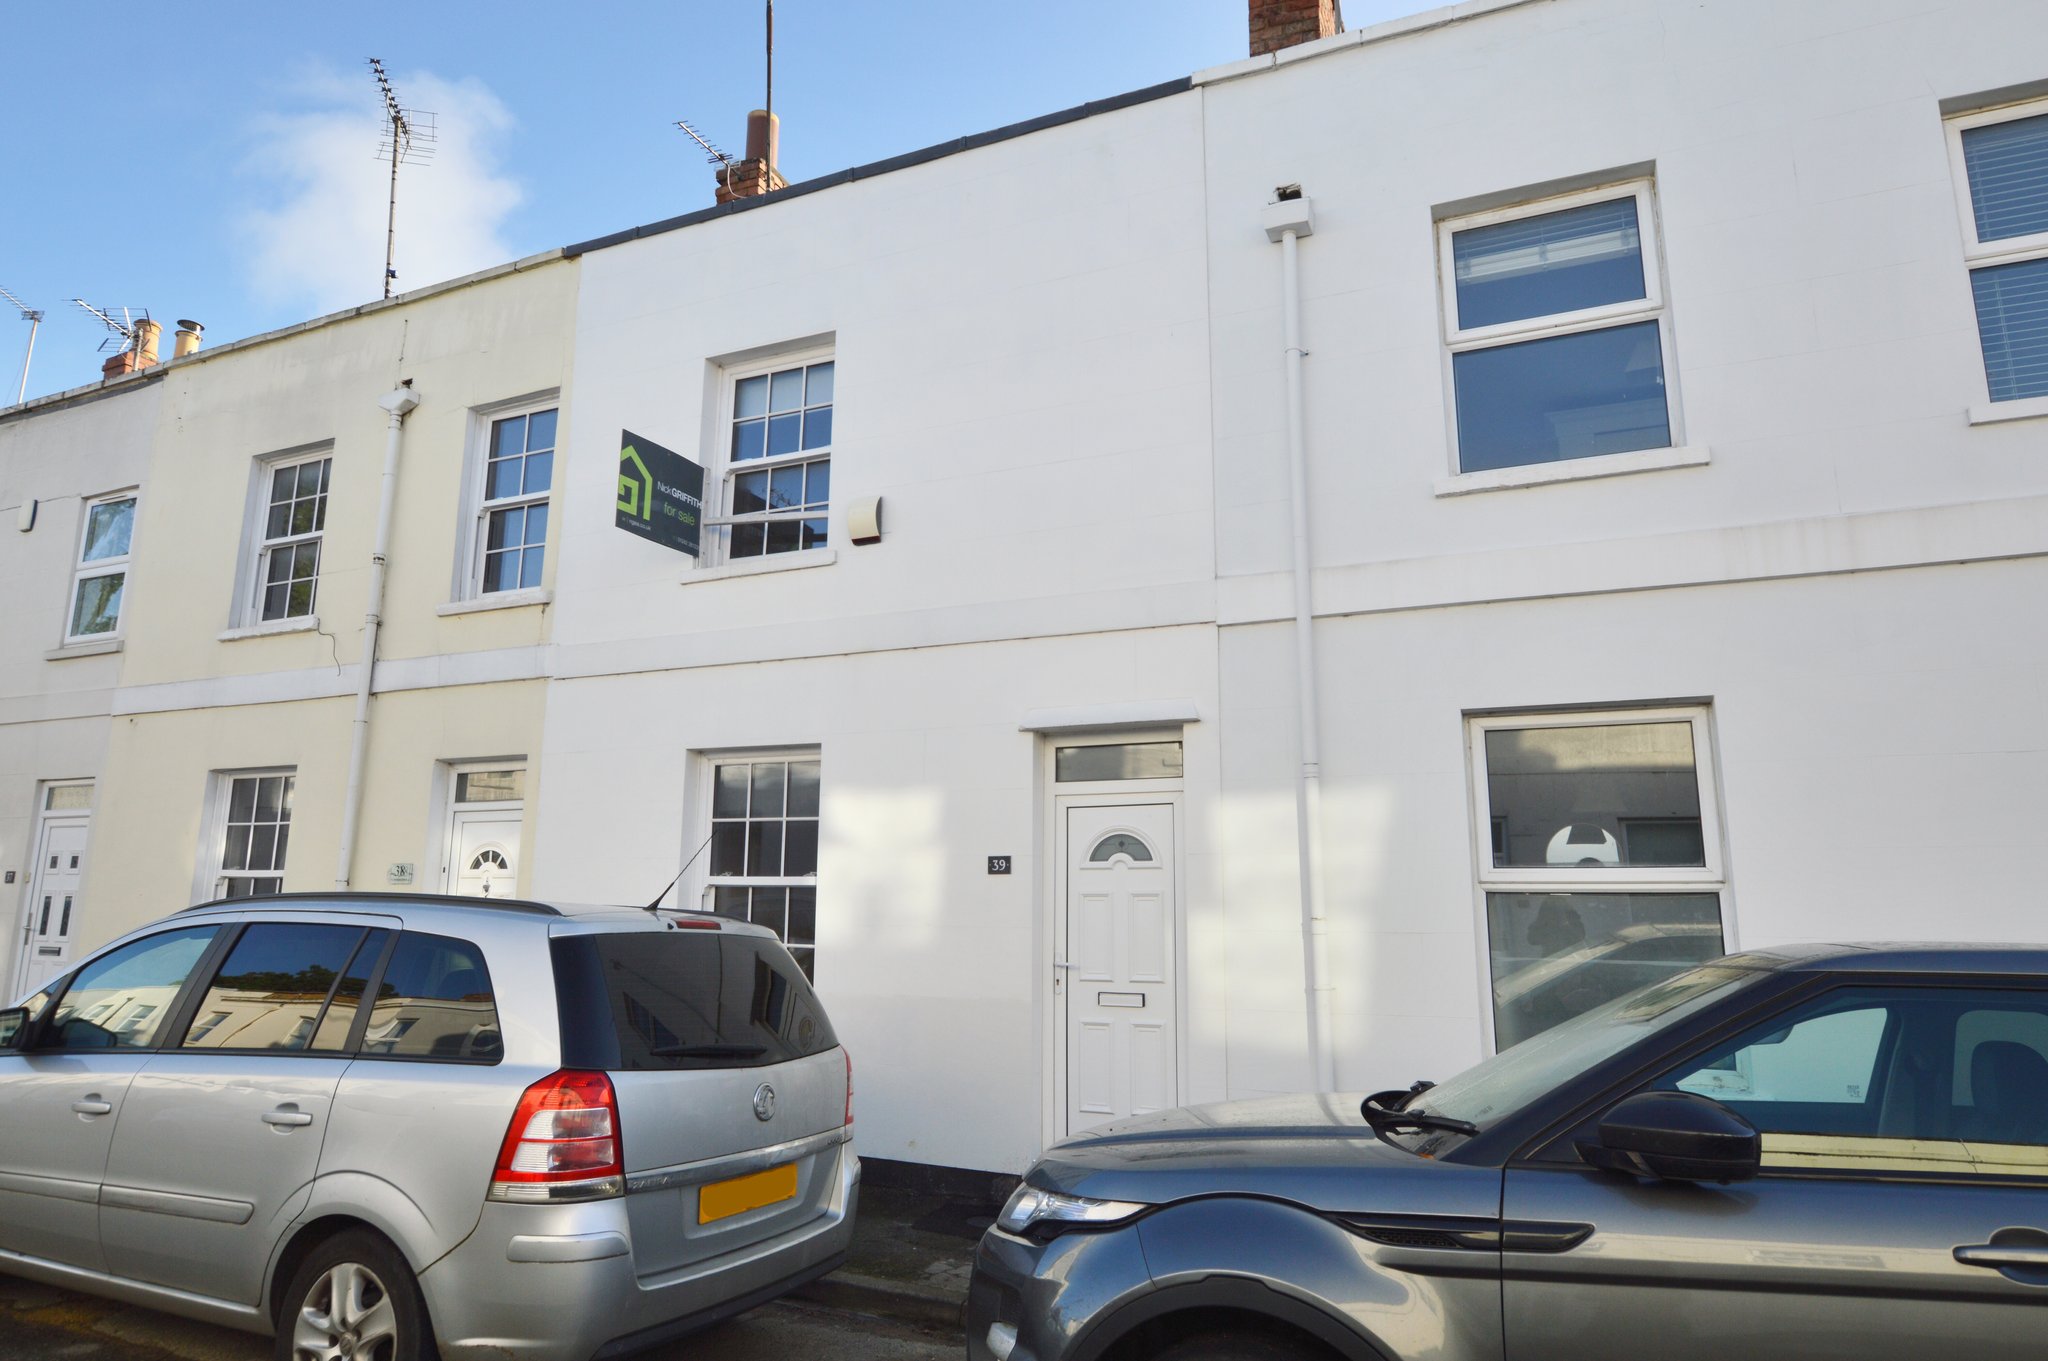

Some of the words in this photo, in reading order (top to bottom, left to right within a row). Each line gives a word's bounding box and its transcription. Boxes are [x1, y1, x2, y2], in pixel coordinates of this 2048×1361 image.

[664, 501, 676, 517] for
[678, 510, 695, 526] sale
[991, 859, 1006, 871] 39
